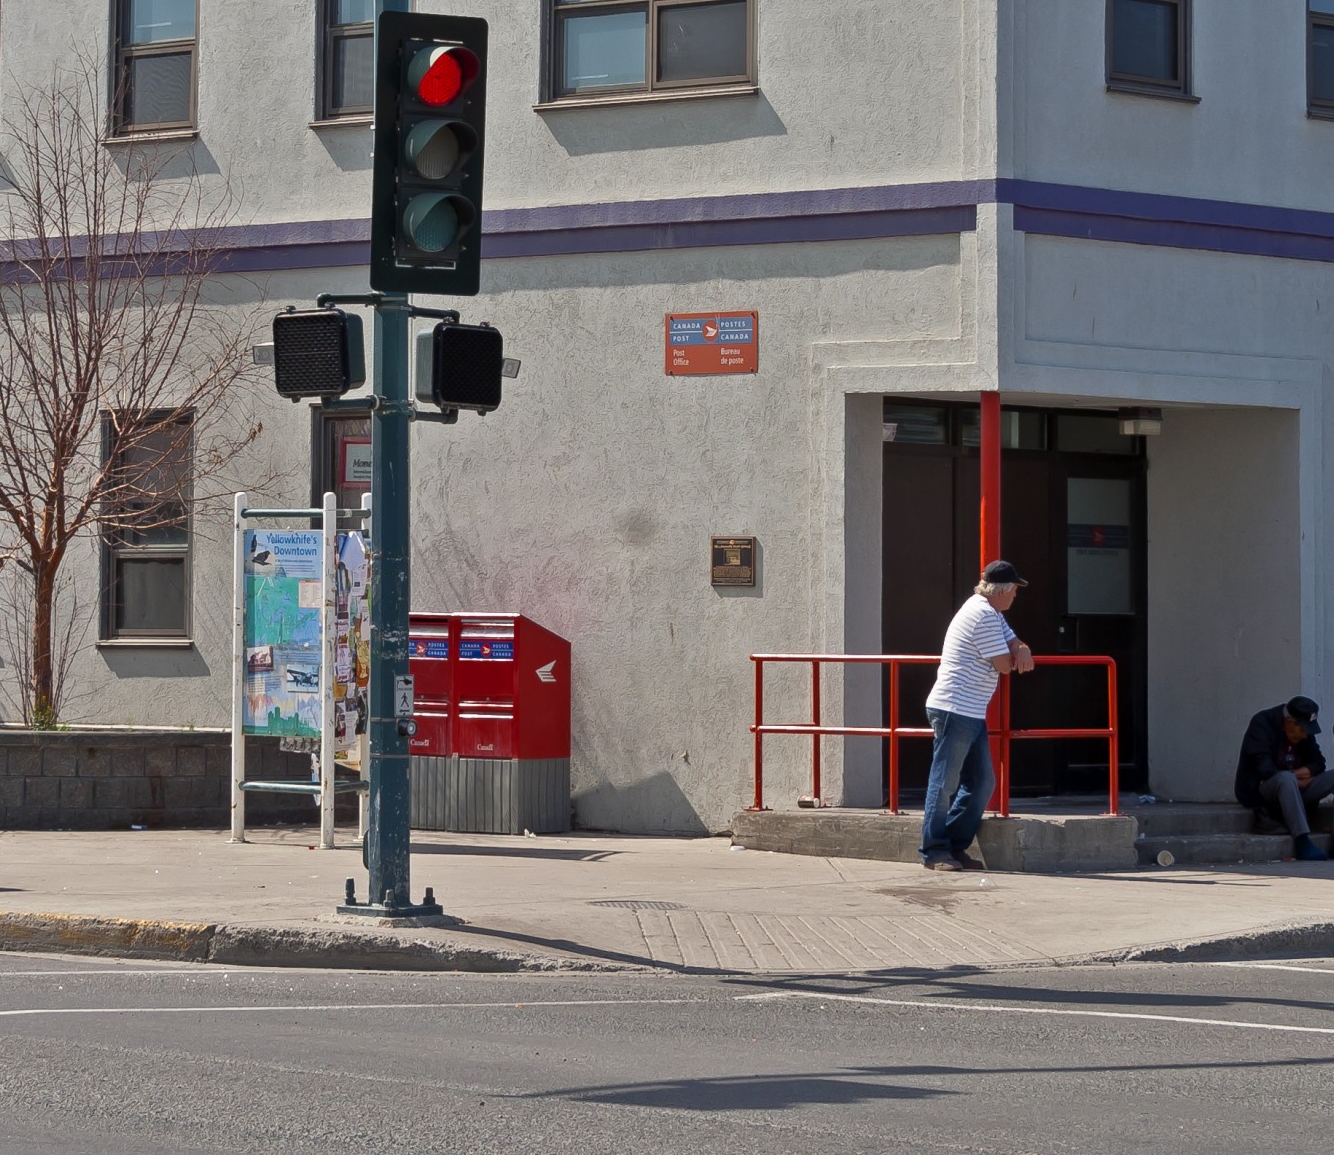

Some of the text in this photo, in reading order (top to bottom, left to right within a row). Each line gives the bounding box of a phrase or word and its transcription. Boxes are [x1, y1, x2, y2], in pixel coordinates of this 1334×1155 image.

[673, 349, 685, 357] Post
[720, 347, 741, 355] Bureau
[673, 358, 689, 366] Office
[720, 357, 744, 366] de poste
[352, 458, 371, 467] Mone
[266, 533, 318, 545] Yellowknife's
[274, 546, 317, 556] Downtown
